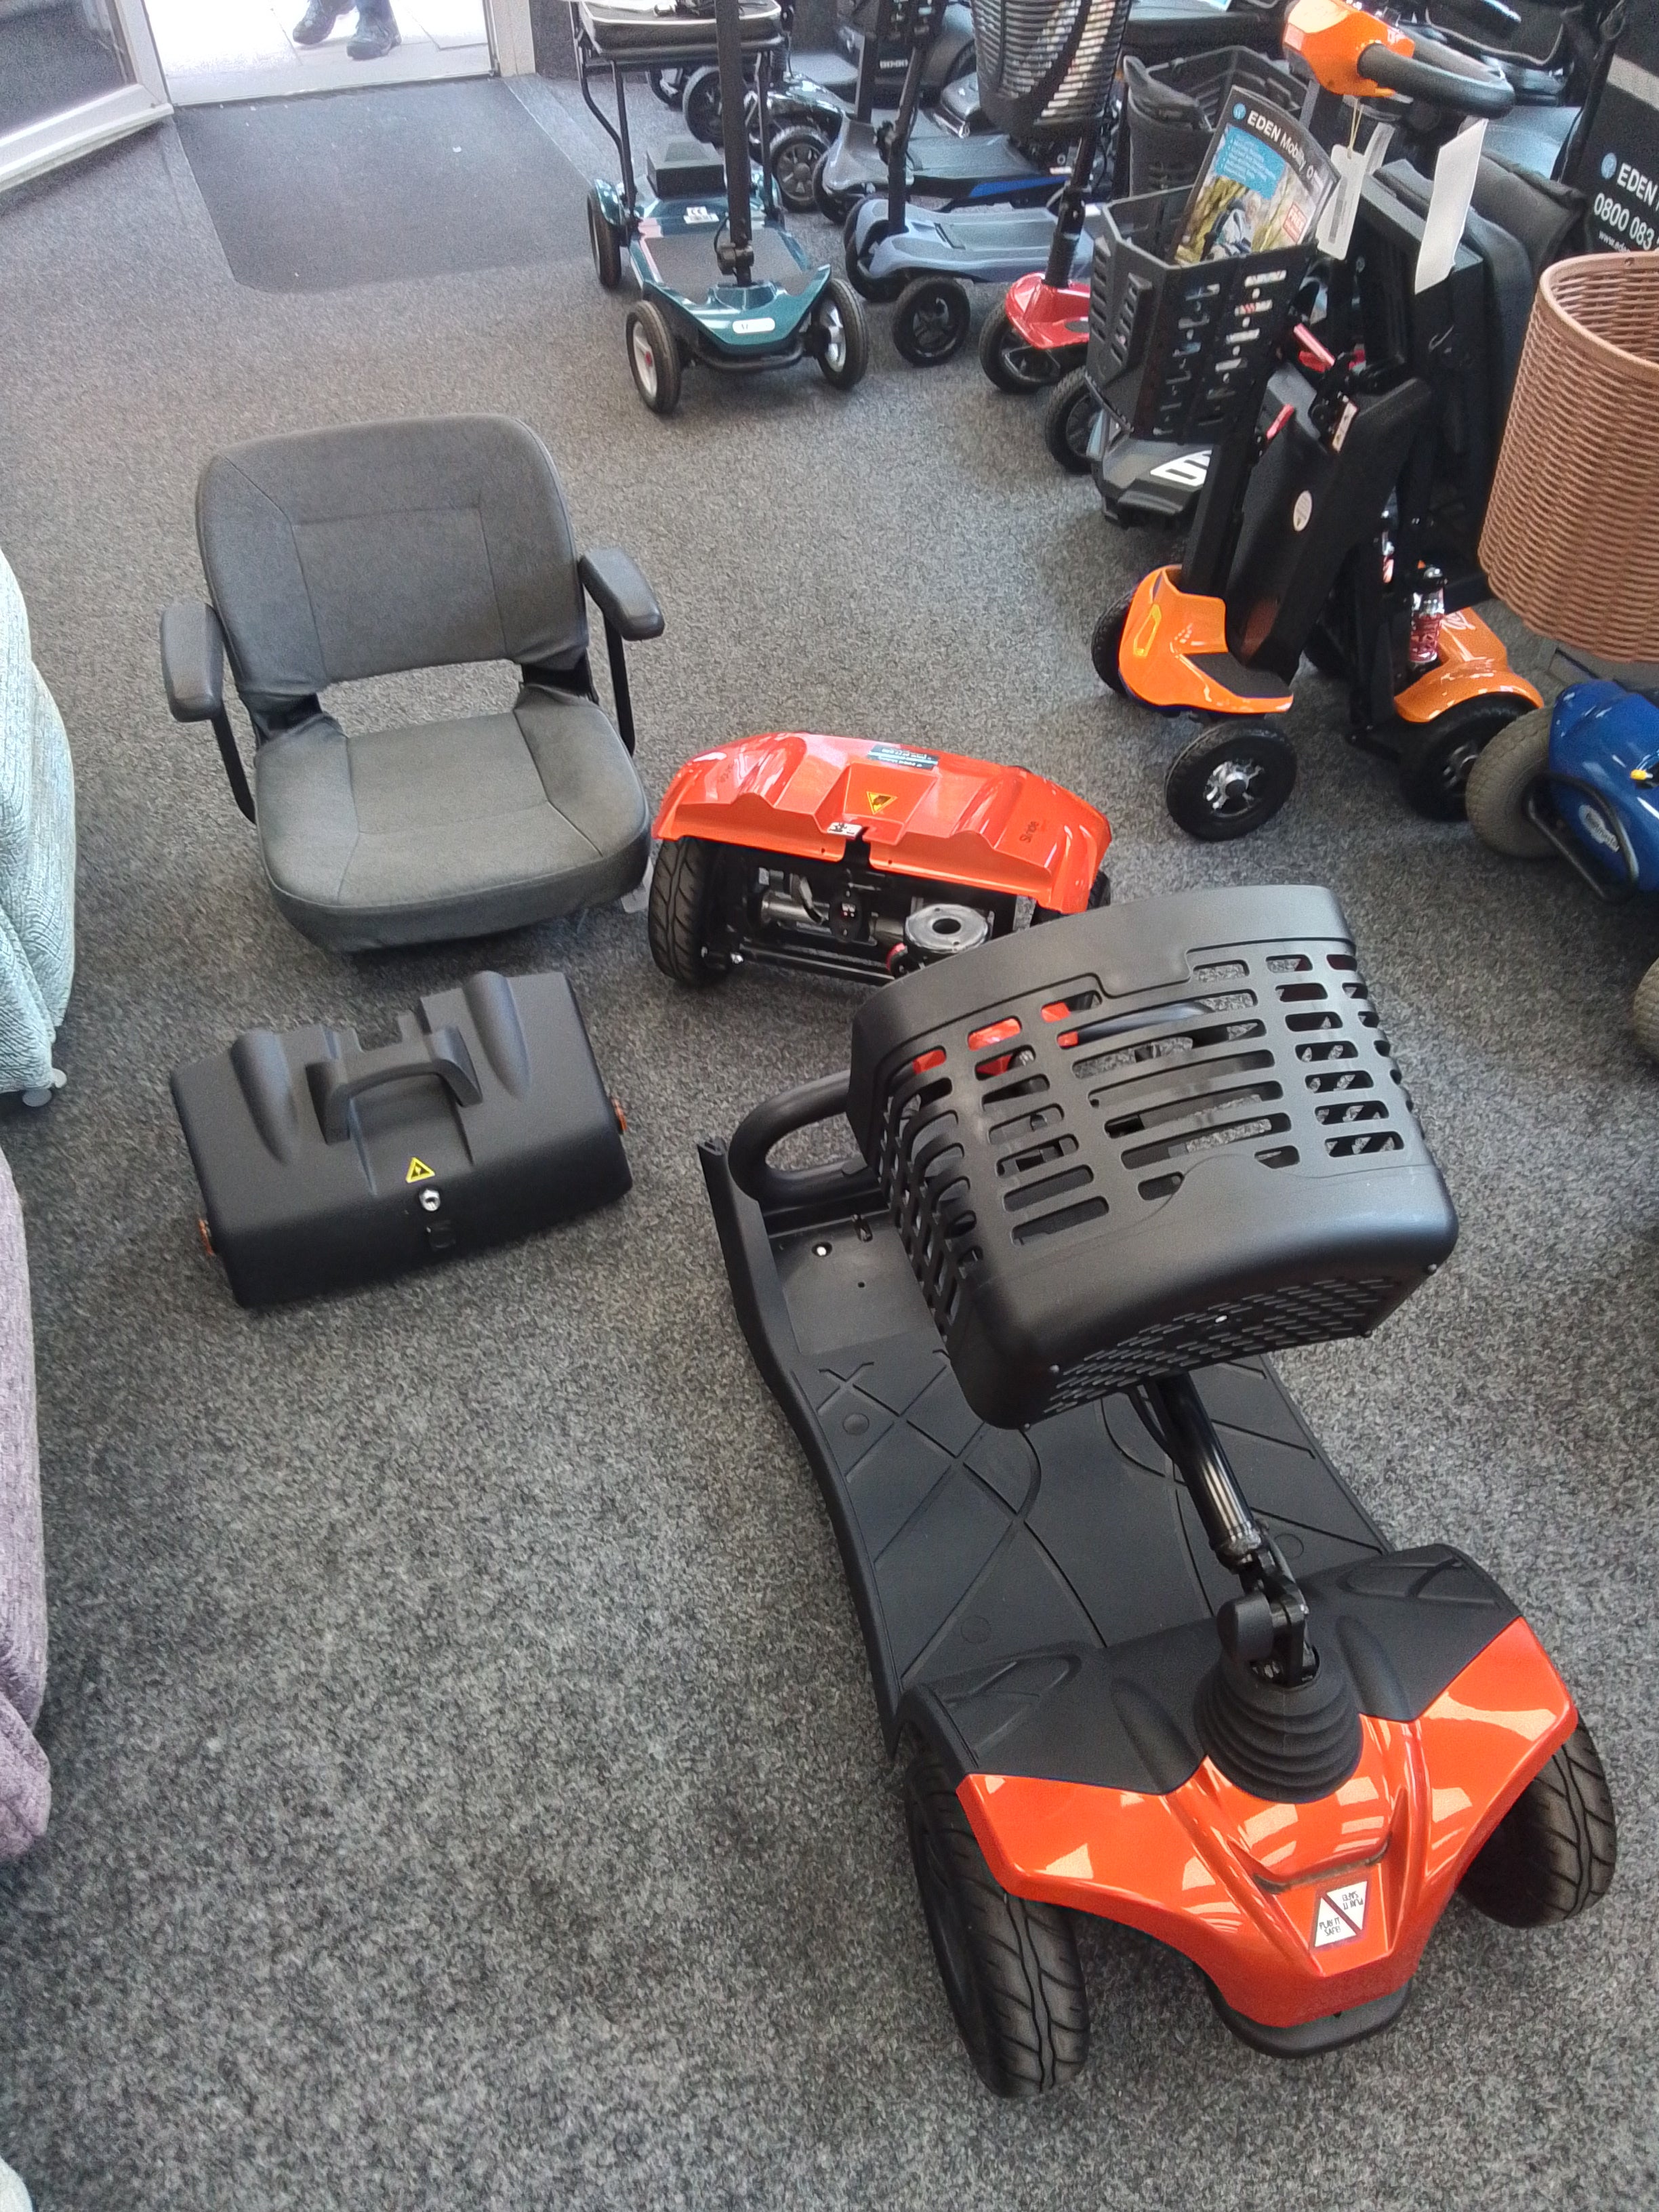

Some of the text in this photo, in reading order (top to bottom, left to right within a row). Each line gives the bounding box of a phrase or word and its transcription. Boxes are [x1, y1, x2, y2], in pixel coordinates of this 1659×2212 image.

[1247, 110, 1281, 142] EDEN
[1617, 163, 1658, 207] EDEN
[1594, 192, 1655, 251] 0800 083
[1319, 1917, 1340, 1930] PLAY IT
